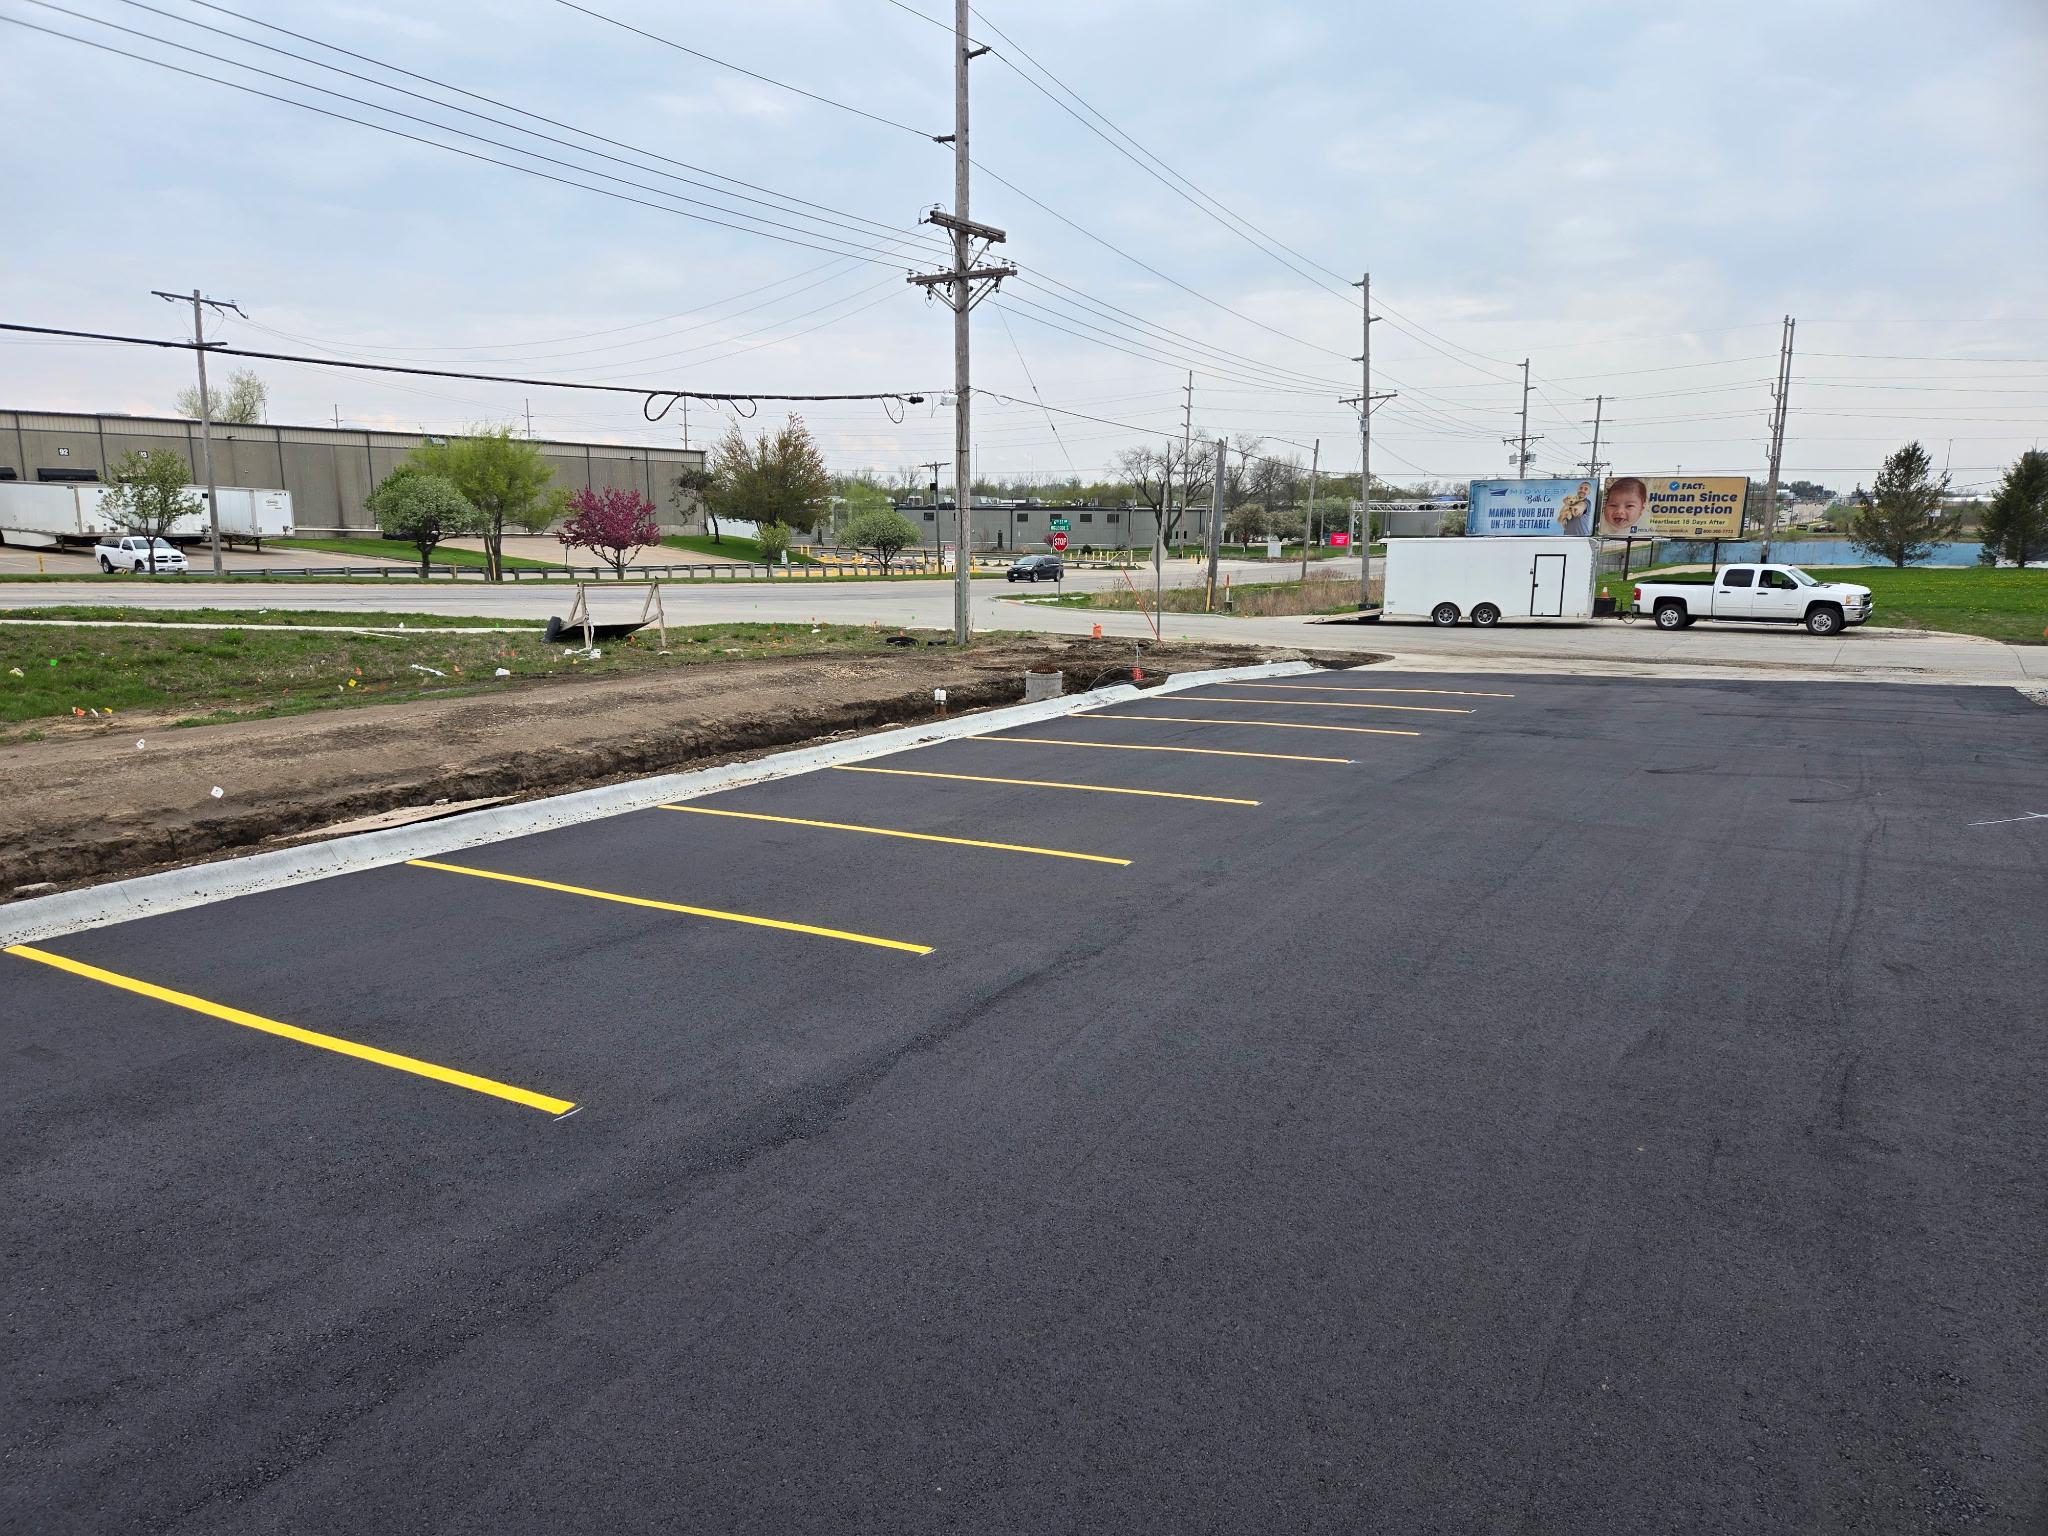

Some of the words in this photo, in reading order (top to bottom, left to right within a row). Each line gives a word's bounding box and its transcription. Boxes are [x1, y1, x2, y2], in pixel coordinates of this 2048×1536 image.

[59, 448, 69, 456] 92
[1525, 494, 1542, 504] Bath
[1649, 492, 1695, 502] Human
[1699, 491, 1738, 502] Since
[1488, 508, 1516, 518] MAKING
[1517, 508, 1535, 518] YOUR
[1537, 507, 1555, 517] BATH
[1651, 503, 1733, 516] Conception
[1055, 537, 1066, 546] STOP
